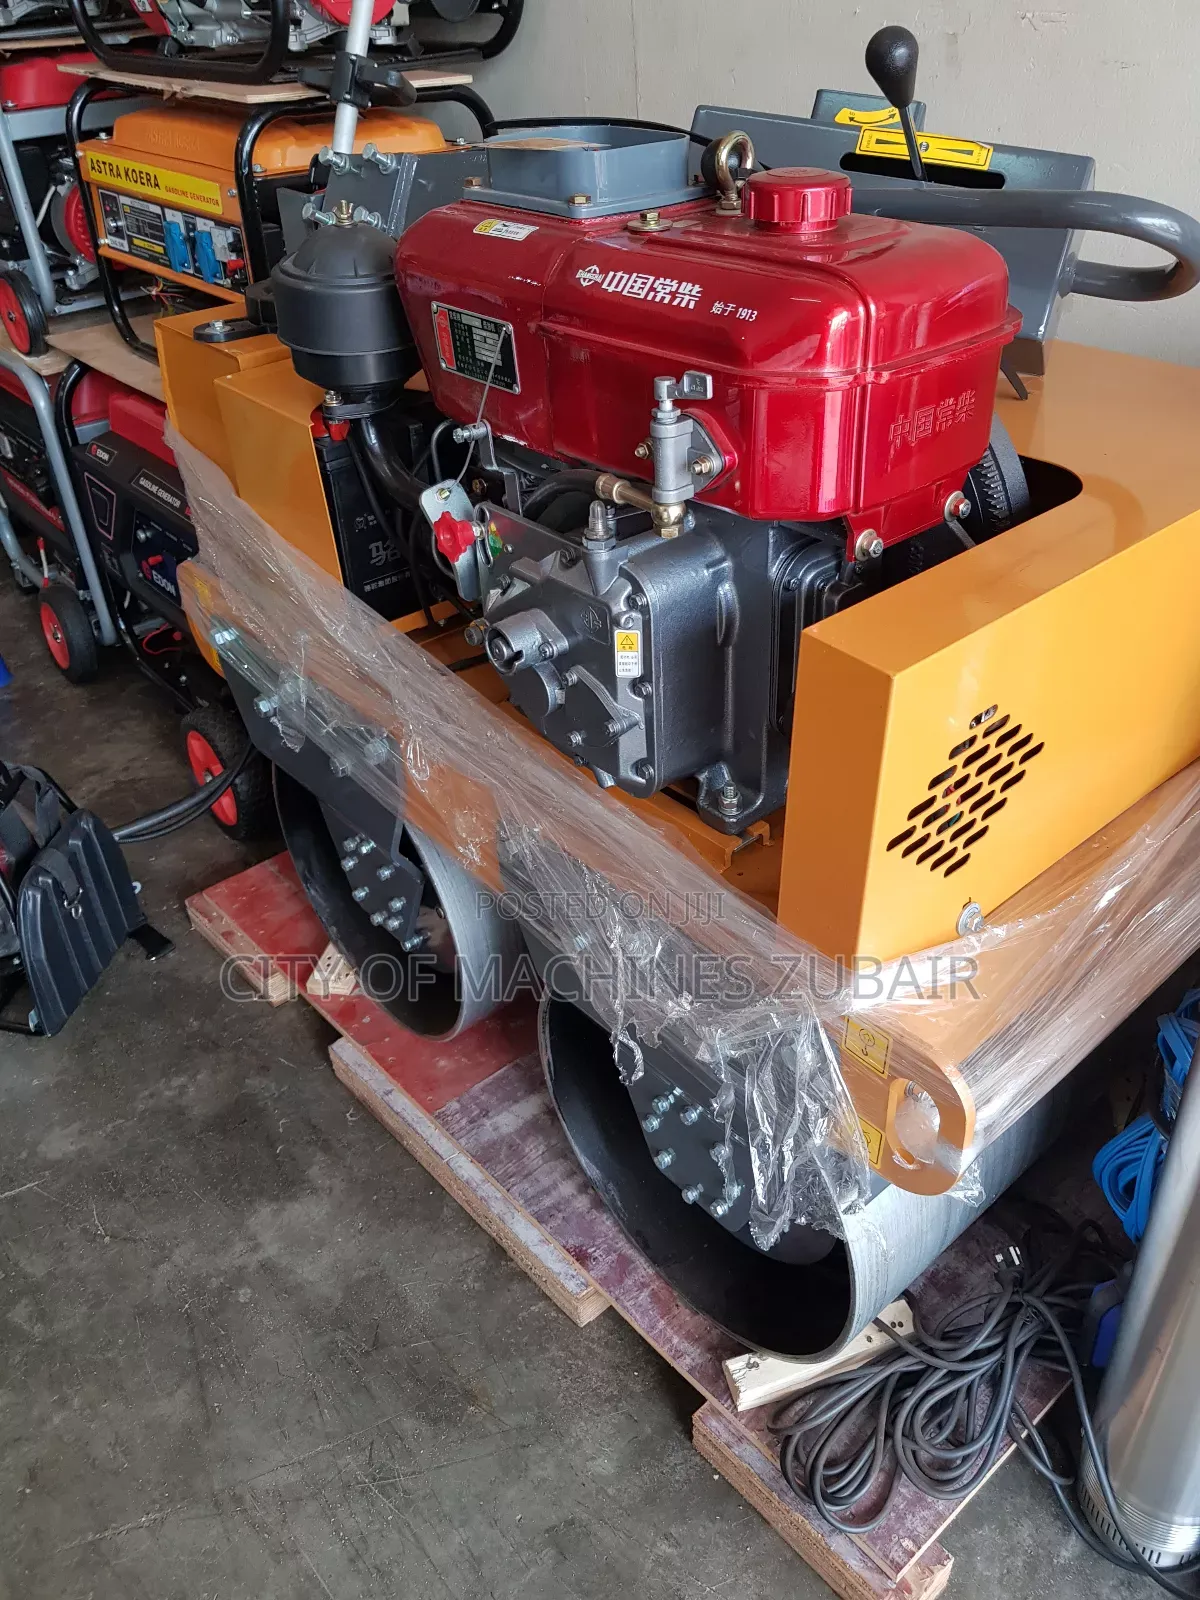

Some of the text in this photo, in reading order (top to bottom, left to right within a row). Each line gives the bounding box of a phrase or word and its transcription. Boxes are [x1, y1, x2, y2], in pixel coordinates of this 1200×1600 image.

[90, 157, 161, 190] ASTRA KOERA
[164, 185, 220, 207] GASOLINE GENERATOR
[601, 270, 704, 310] 中国常柴
[709, 300, 758, 322] 始于 1913
[888, 389, 976, 449] 中国常柴
[96, 448, 110, 462] EDON
[152, 571, 176, 597] EDON
